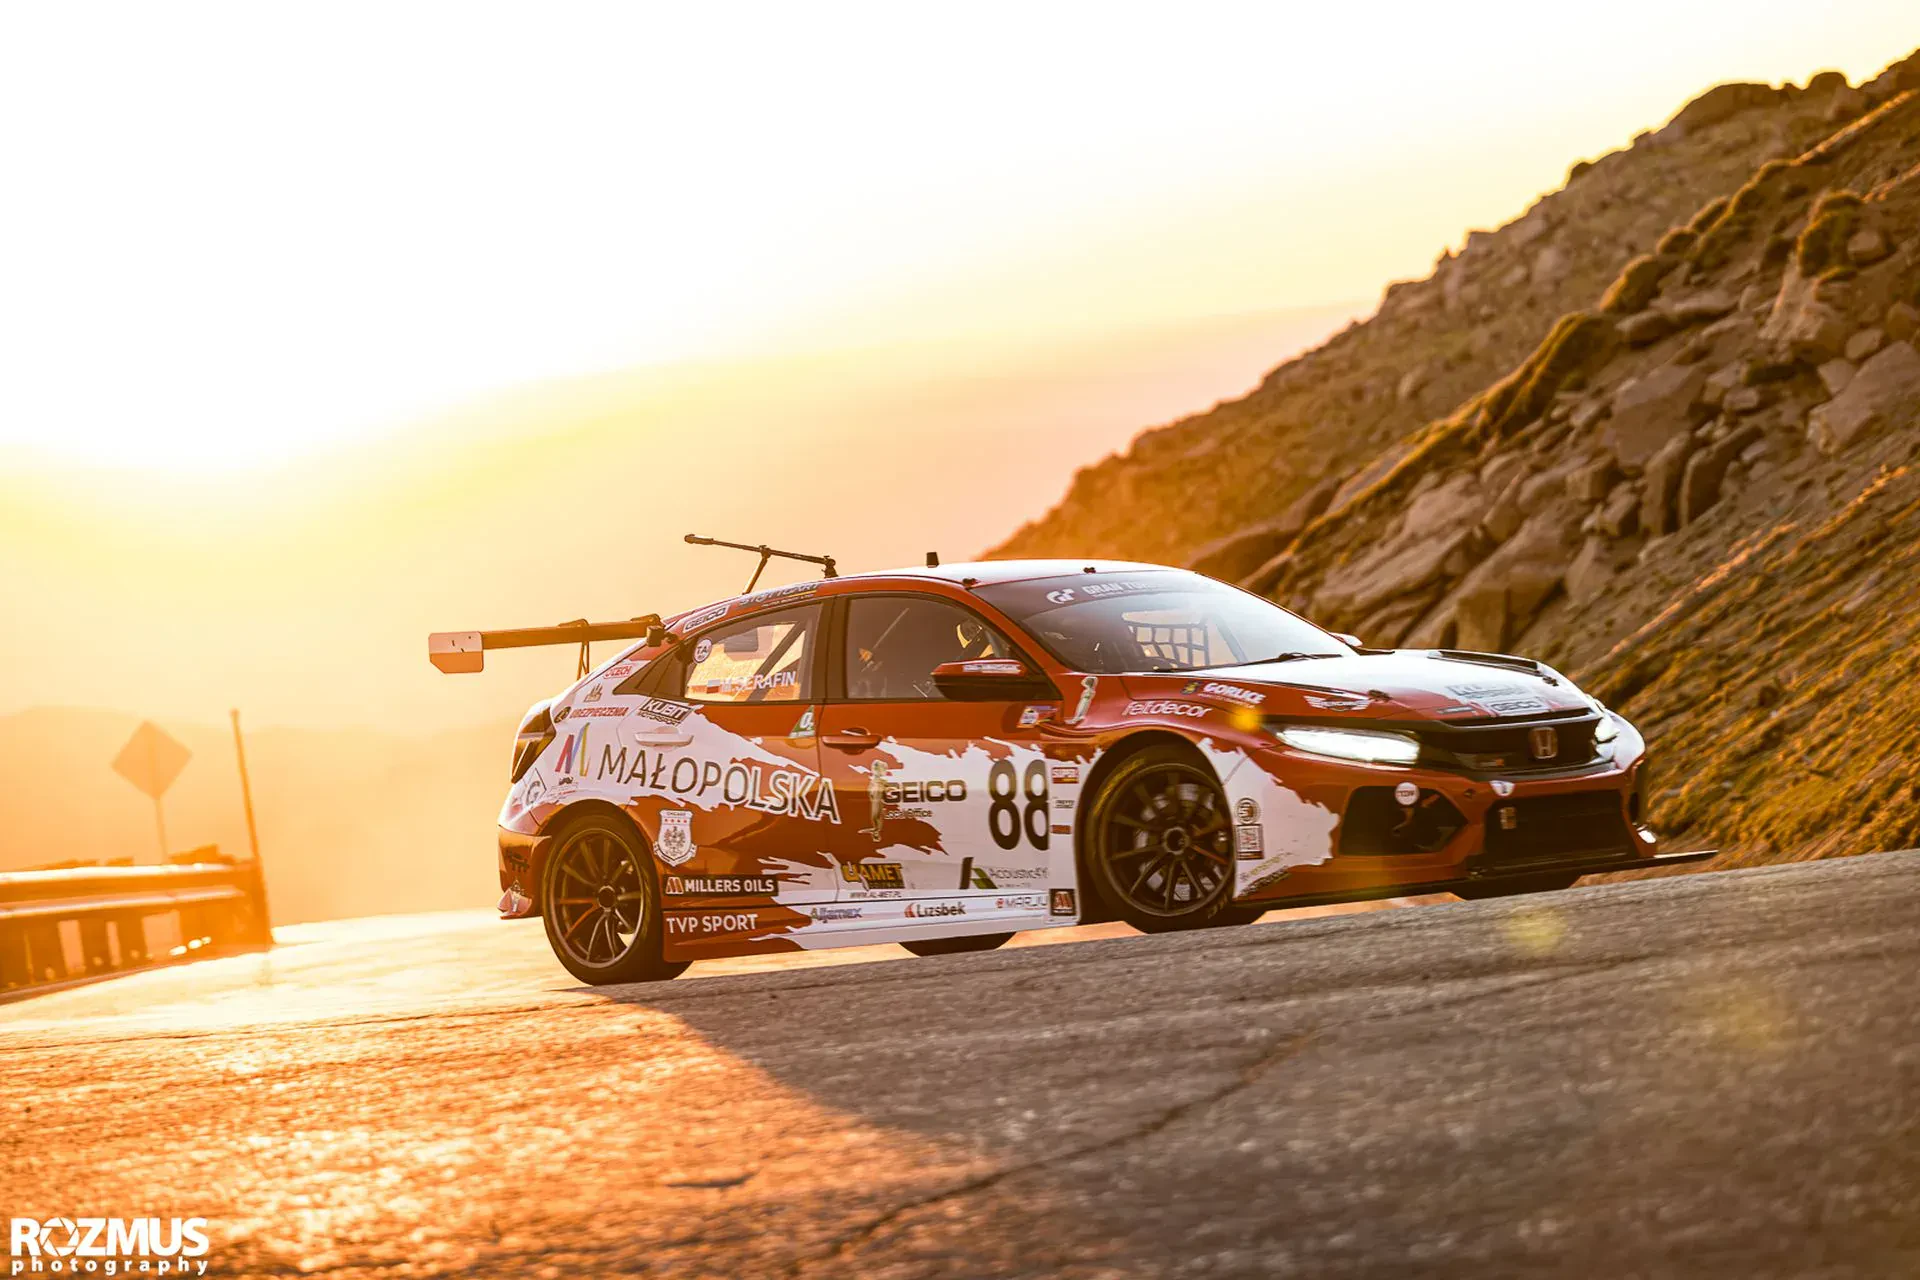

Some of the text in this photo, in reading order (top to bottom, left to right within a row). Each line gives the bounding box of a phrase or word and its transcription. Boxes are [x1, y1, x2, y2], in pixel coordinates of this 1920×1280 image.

[685, 607, 726, 630] GEICO
[643, 699, 688, 719] KUBIT
[597, 744, 840, 823] MAŁOPOLSKA
[883, 780, 967, 803] GEICO
[988, 759, 1050, 850] 88
[685, 879, 774, 893] MILLERS OILS
[666, 914, 758, 933] TVP SPORT
